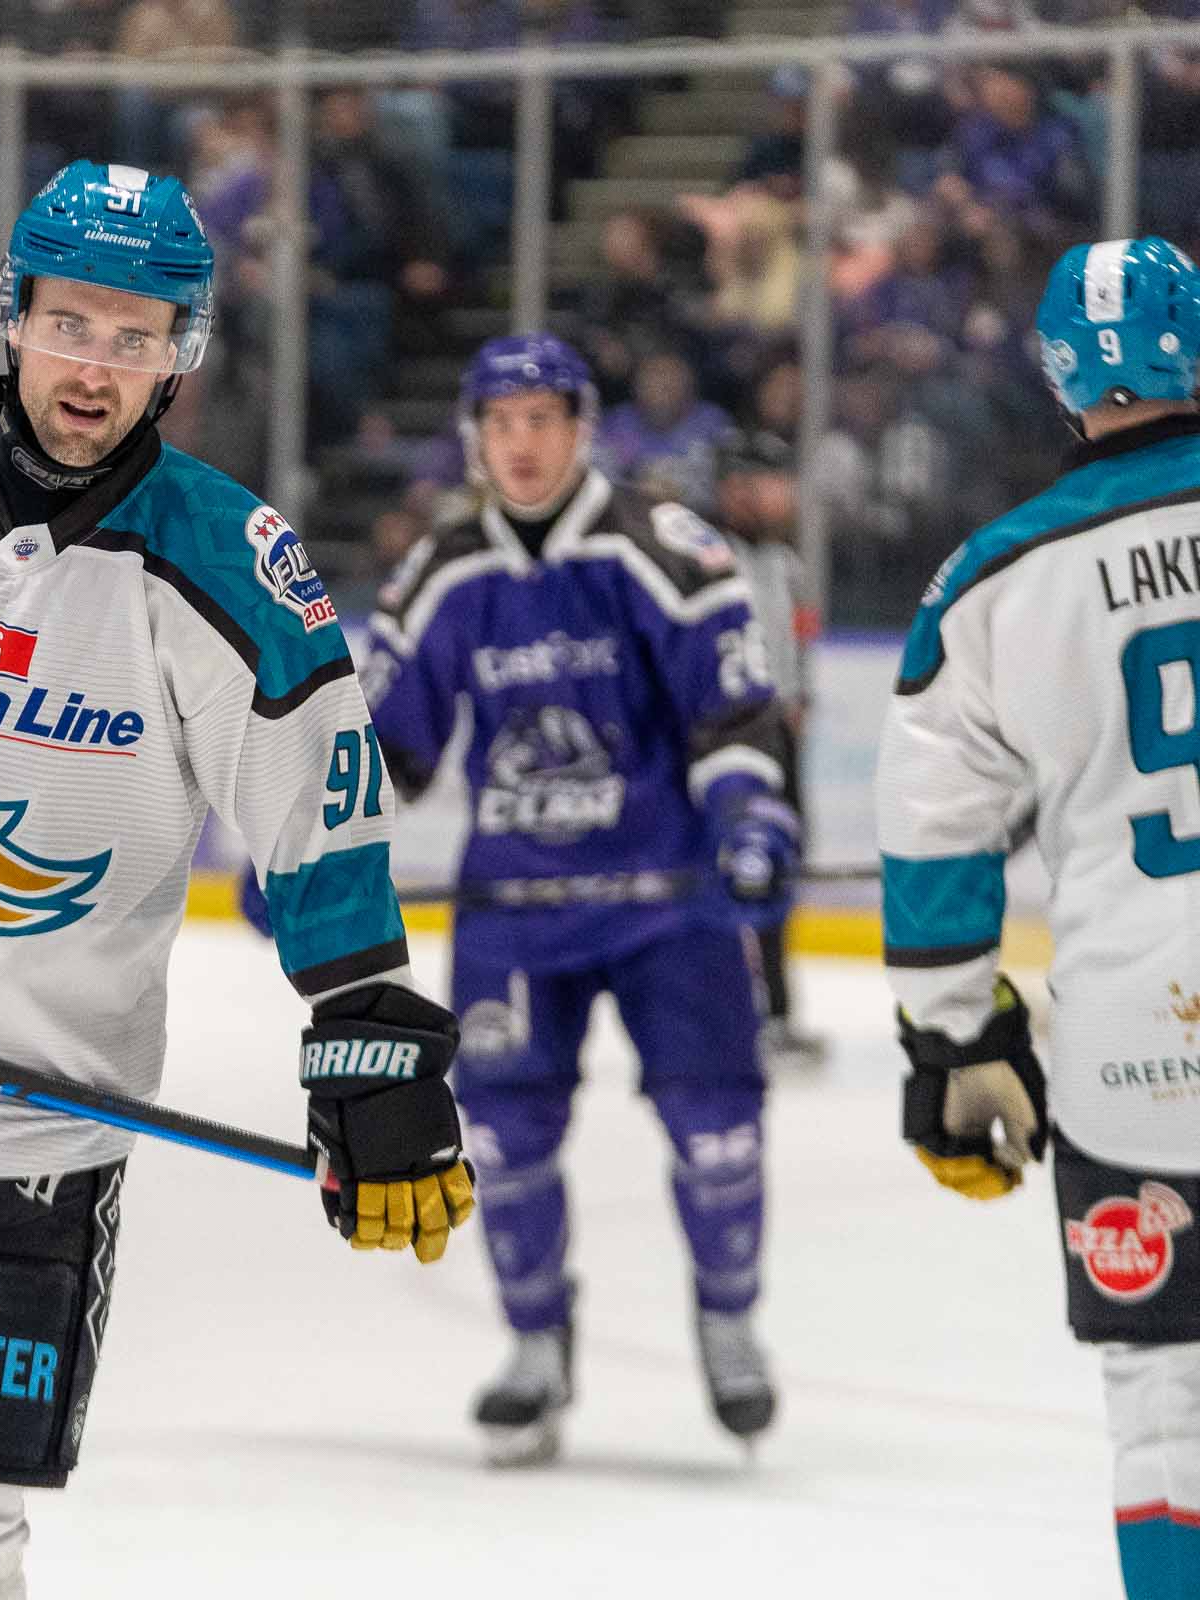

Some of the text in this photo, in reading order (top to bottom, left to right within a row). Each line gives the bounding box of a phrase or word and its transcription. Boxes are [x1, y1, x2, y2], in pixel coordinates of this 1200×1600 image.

[84, 230, 151, 249] WARRIOR
[1098, 328, 1122, 366] 9
[13, 688, 145, 747] Line
[323, 723, 383, 831] 91
[300, 1037, 420, 1079] RRIOR
